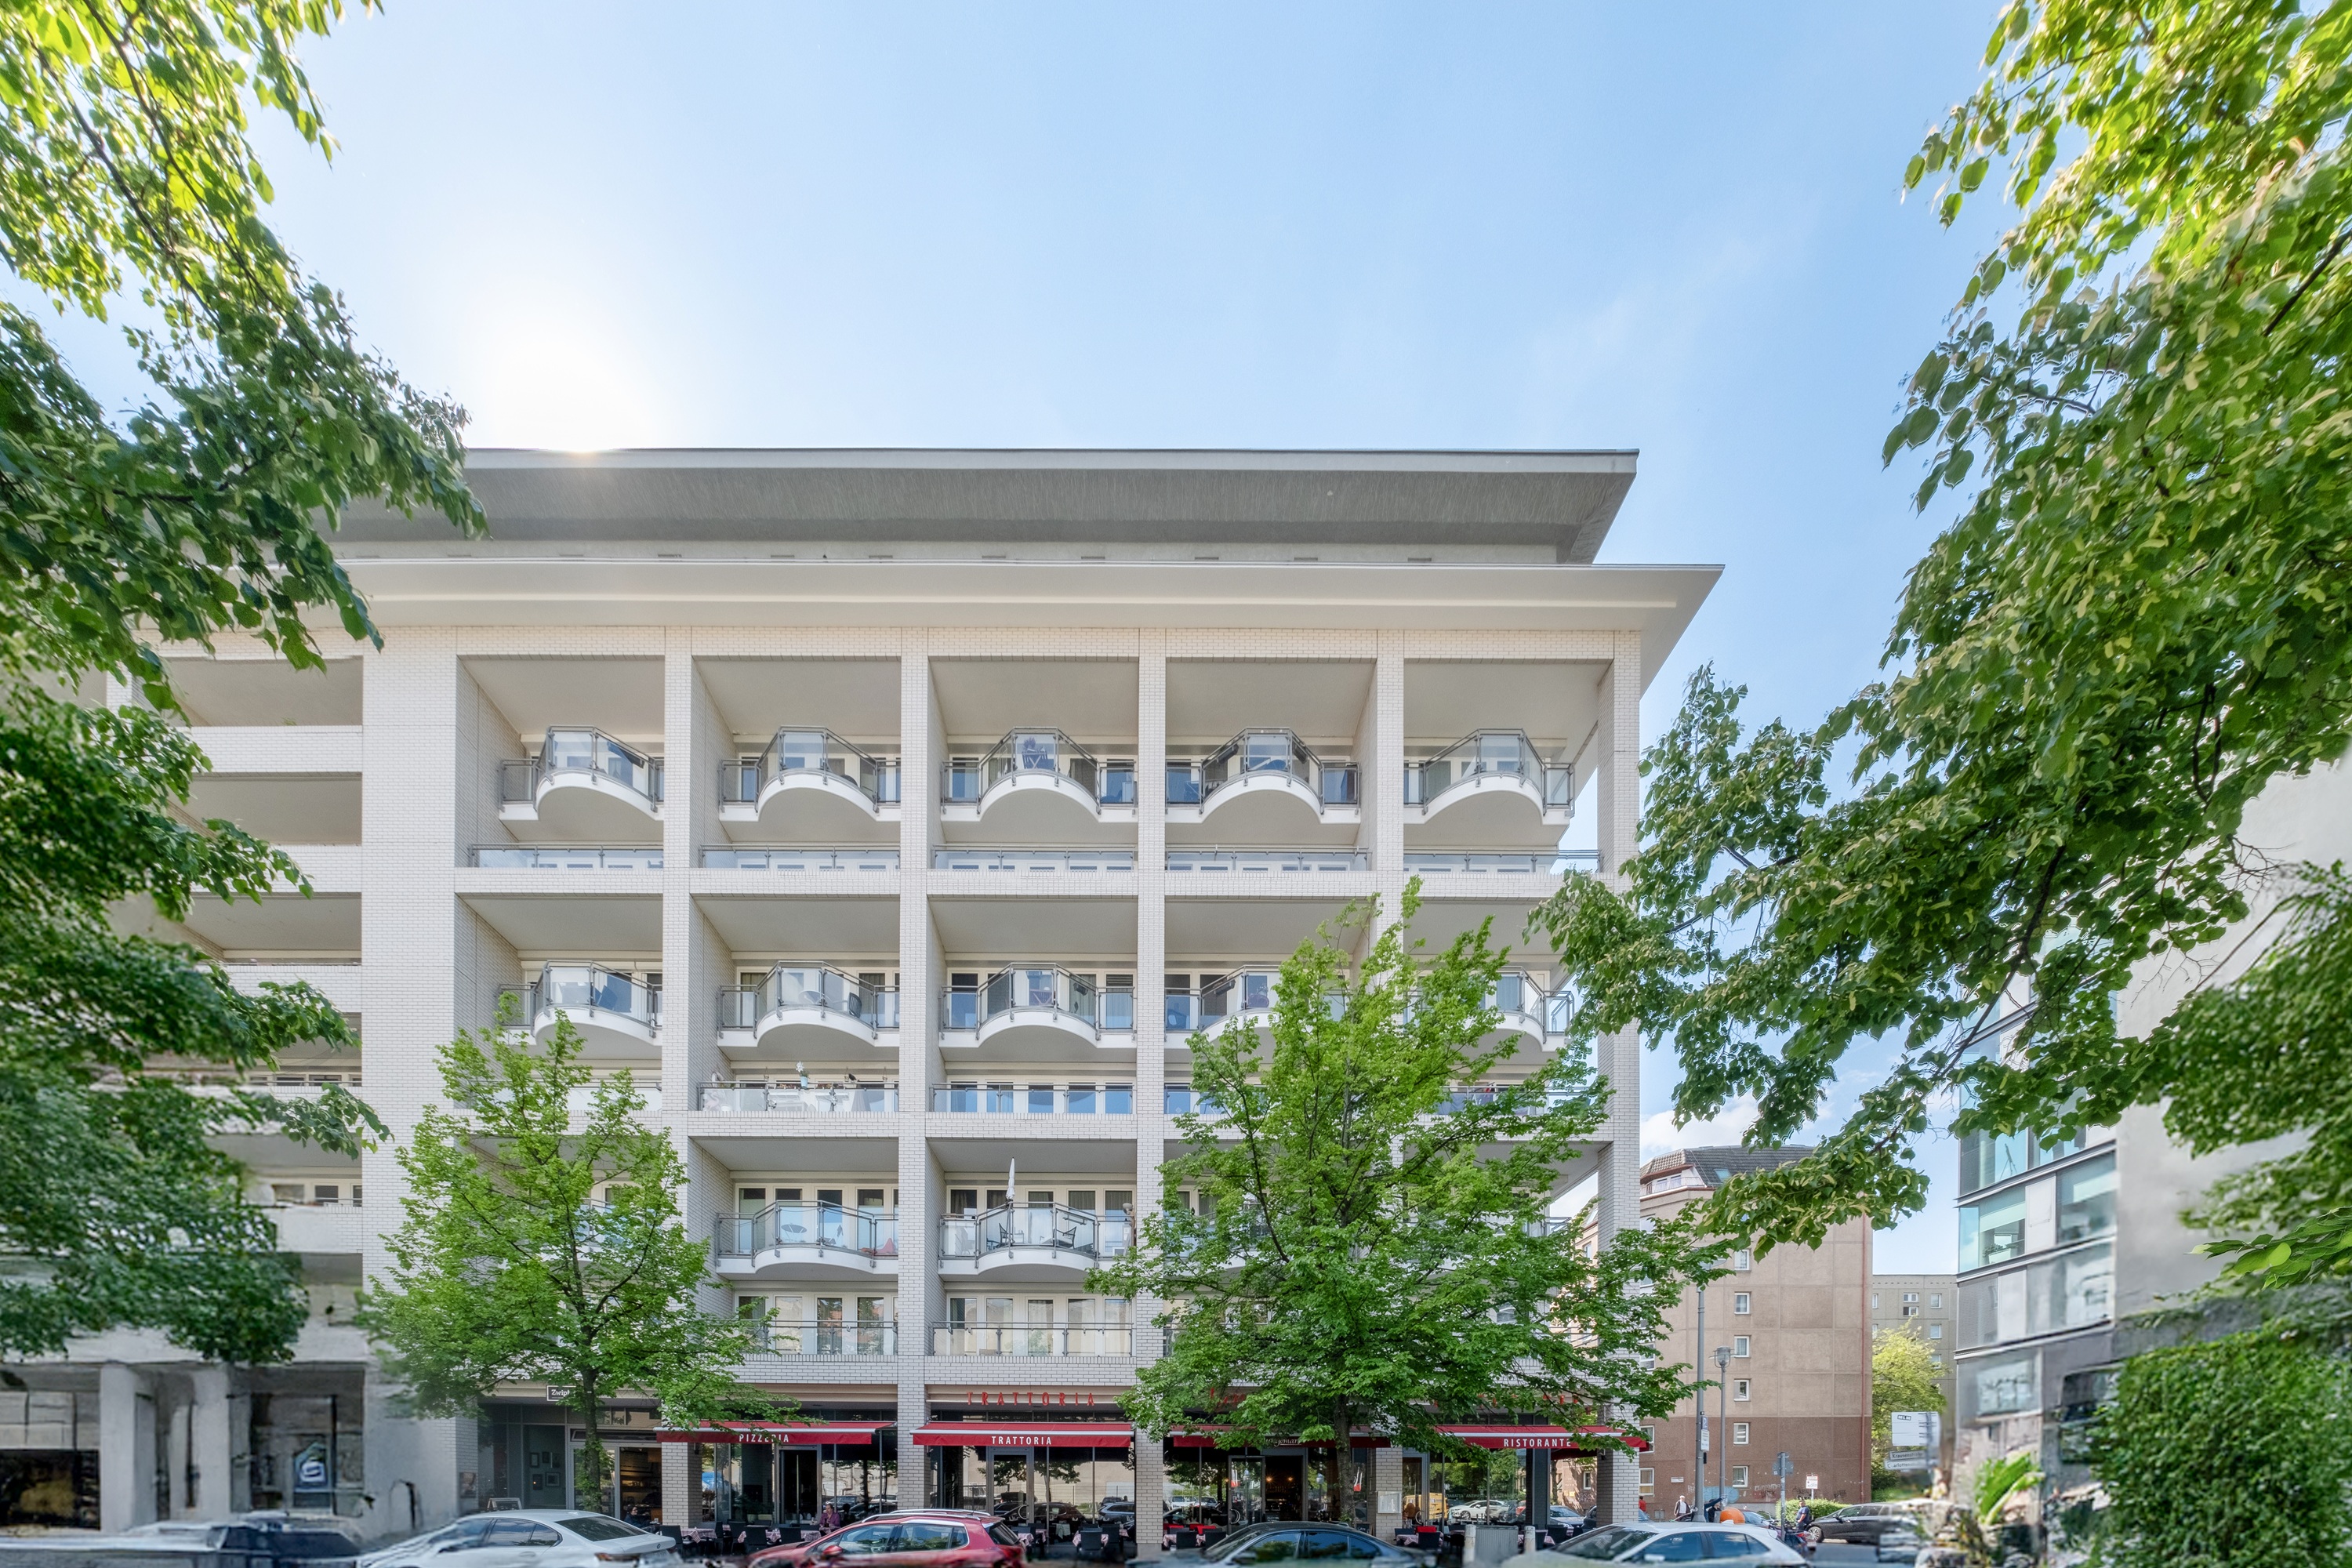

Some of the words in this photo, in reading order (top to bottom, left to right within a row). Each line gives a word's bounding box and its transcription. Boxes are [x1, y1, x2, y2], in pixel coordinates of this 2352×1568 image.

[967, 1392, 1094, 1406] TRATTORIA
[992, 1436, 1051, 1445] TRATTORIA
[1262, 1438, 1301, 1447] ungomar
[1504, 1439, 1571, 1447] RISTORANTE
